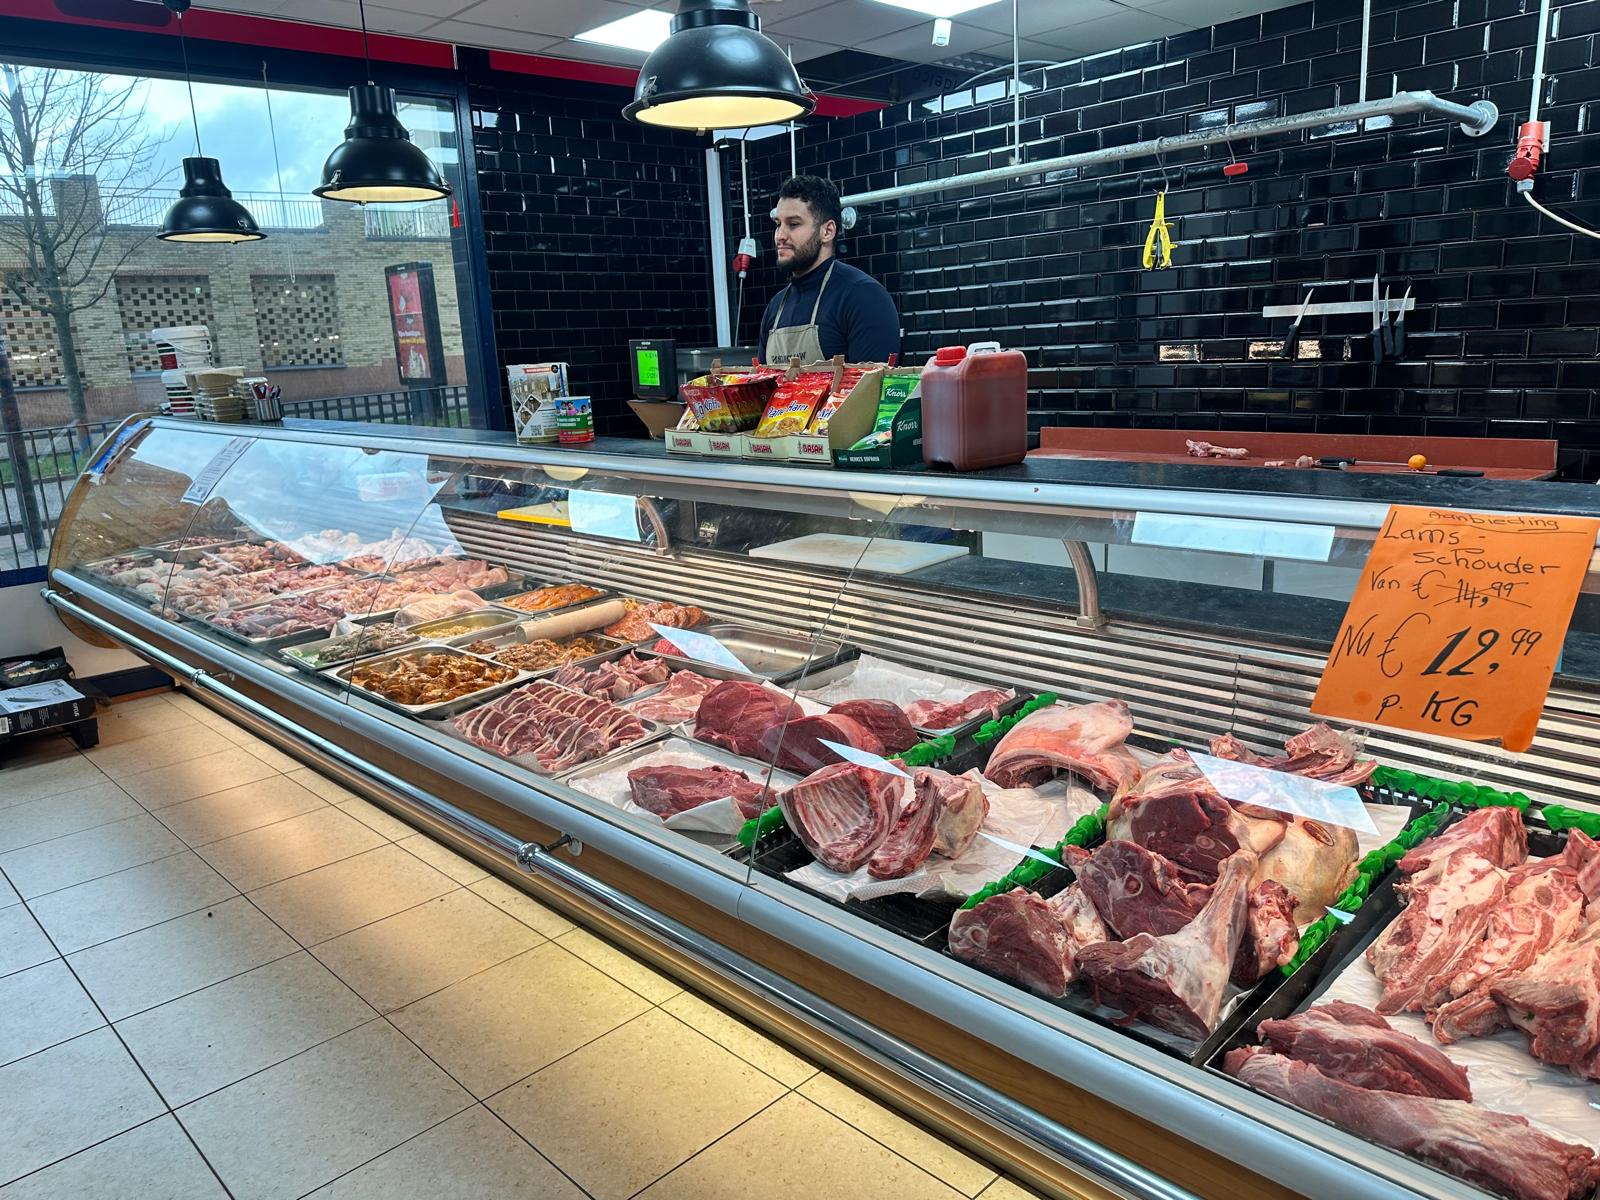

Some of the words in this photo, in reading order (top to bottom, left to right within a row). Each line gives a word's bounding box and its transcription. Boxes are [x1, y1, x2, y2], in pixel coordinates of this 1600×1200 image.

[897, 419, 918, 432] Knorr
[1412, 548, 1561, 575] Schouder
[1369, 566, 1401, 592] Van
[1411, 570, 1447, 600] €
[1376, 612, 1431, 678] €
